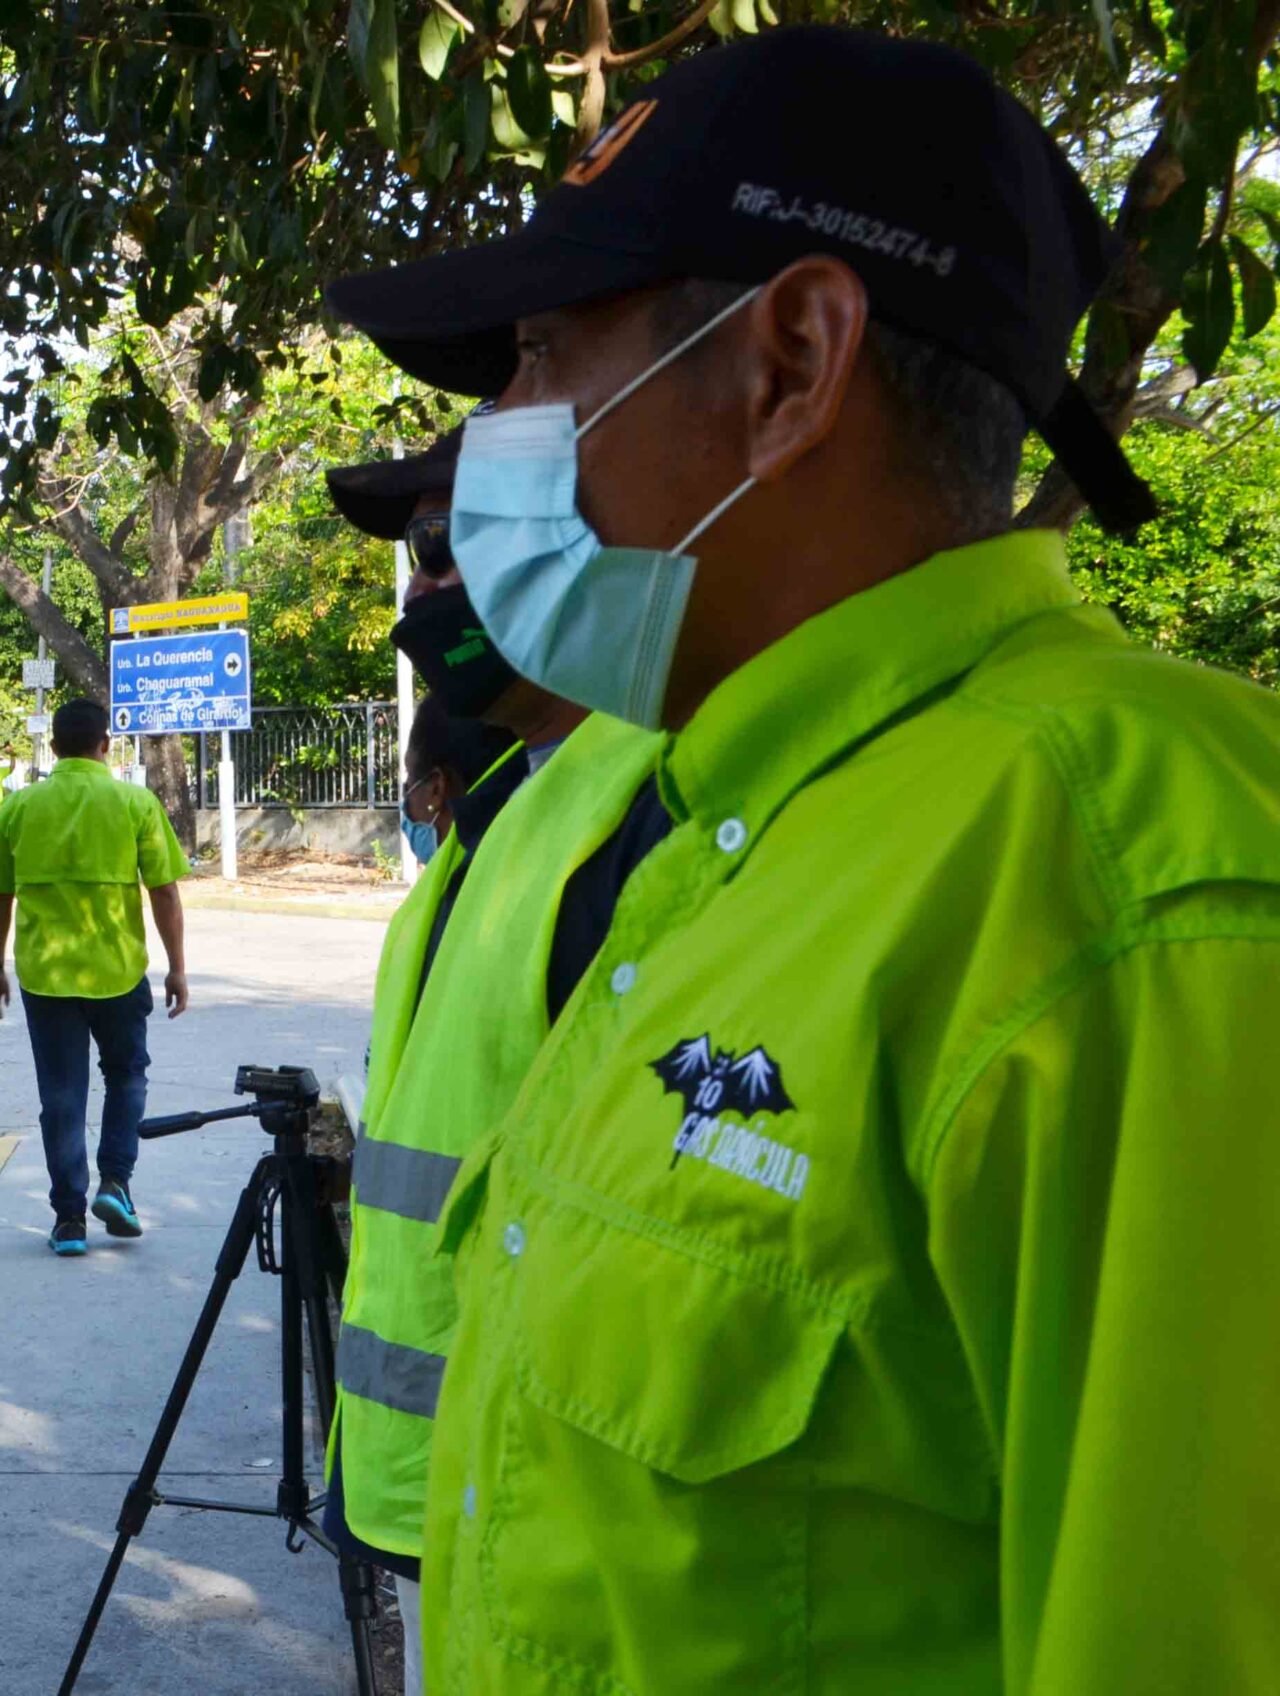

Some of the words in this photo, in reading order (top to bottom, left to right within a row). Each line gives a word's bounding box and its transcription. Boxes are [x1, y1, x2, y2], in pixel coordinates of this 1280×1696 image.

[136, 653, 151, 668] La
[153, 647, 214, 665] Querencia
[136, 672, 214, 693] Chaguaramal
[693, 1076, 723, 1111] 10
[673, 1111, 720, 1159] GAS
